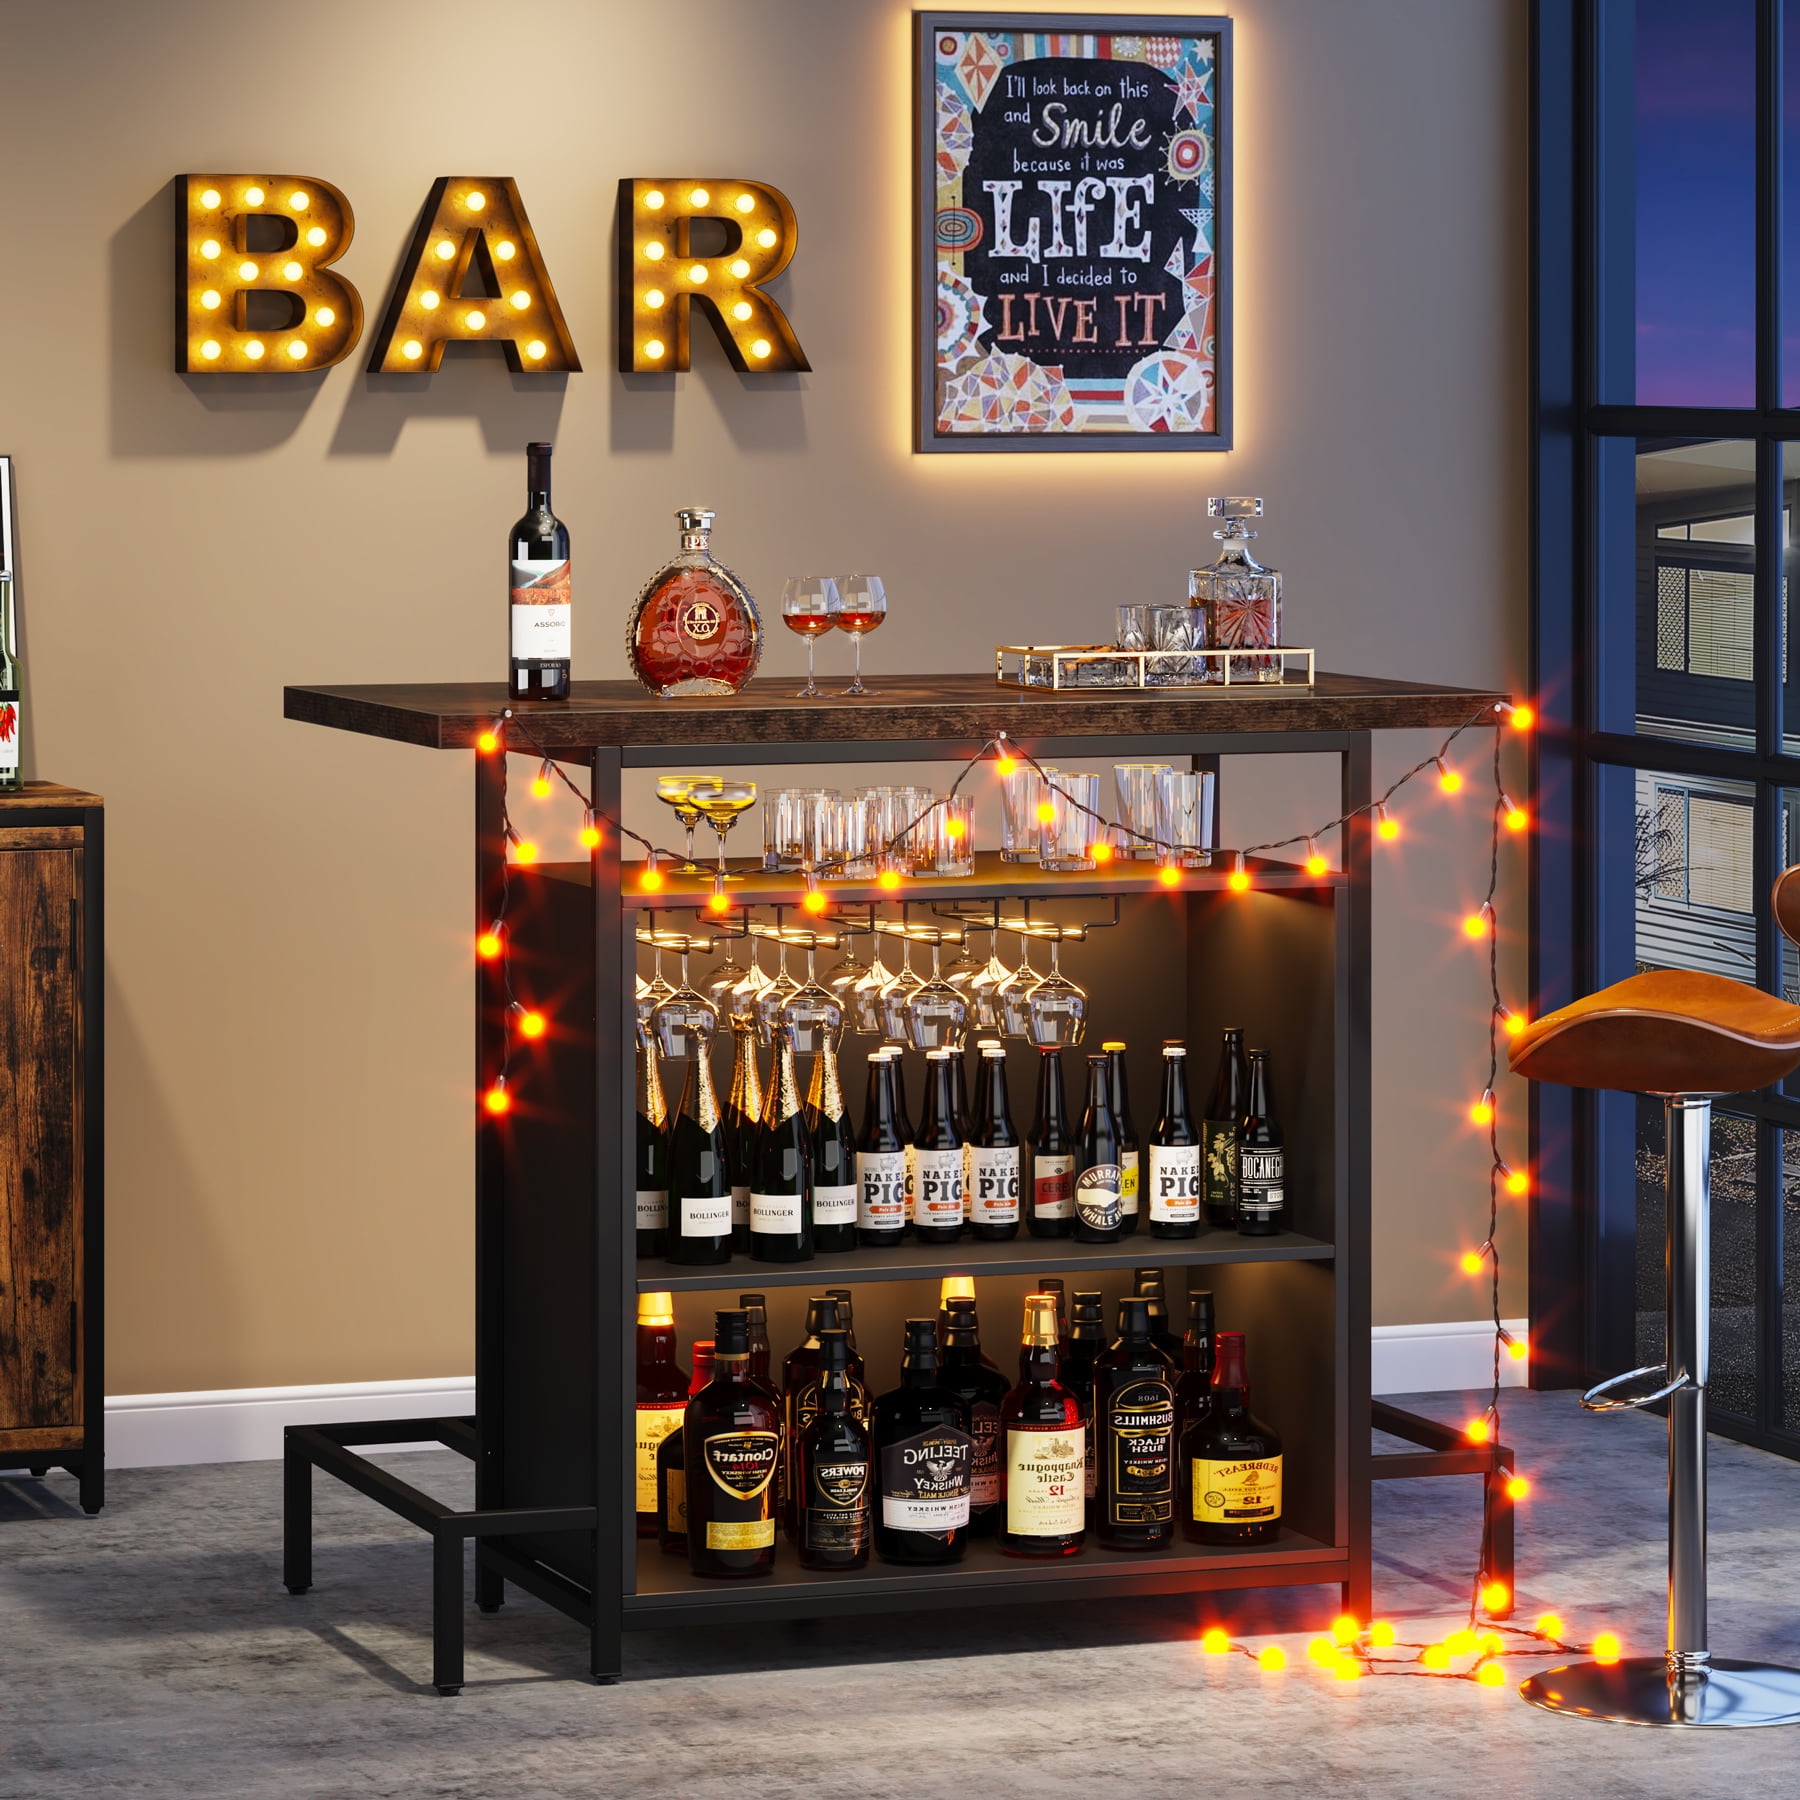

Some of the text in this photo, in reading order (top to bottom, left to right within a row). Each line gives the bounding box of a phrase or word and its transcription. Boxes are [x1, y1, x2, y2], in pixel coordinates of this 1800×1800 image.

[1006, 75, 1149, 98] I'll look back on this
[1004, 102, 1152, 150] and Smile
[1013, 149, 1125, 173] because it was
[175, 174, 813, 374] BAR
[1041, 264, 1051, 286] I
[1056, 266, 1112, 286] decided
[1120, 268, 1138, 285] to
[997, 291, 1168, 348] LIVE IT
[864, 1182, 904, 1204] PIG
[923, 1179, 963, 1201] PIG
[979, 1177, 1019, 1199] PIG
[1160, 1175, 1199, 1197] PIG
[753, 1208, 794, 1217] BOLLINGER
[816, 1198, 856, 1208] BOLLINGER
[689, 1210, 730, 1220] BOLLINGER
[1082, 1206, 1114, 1226] WHALE
